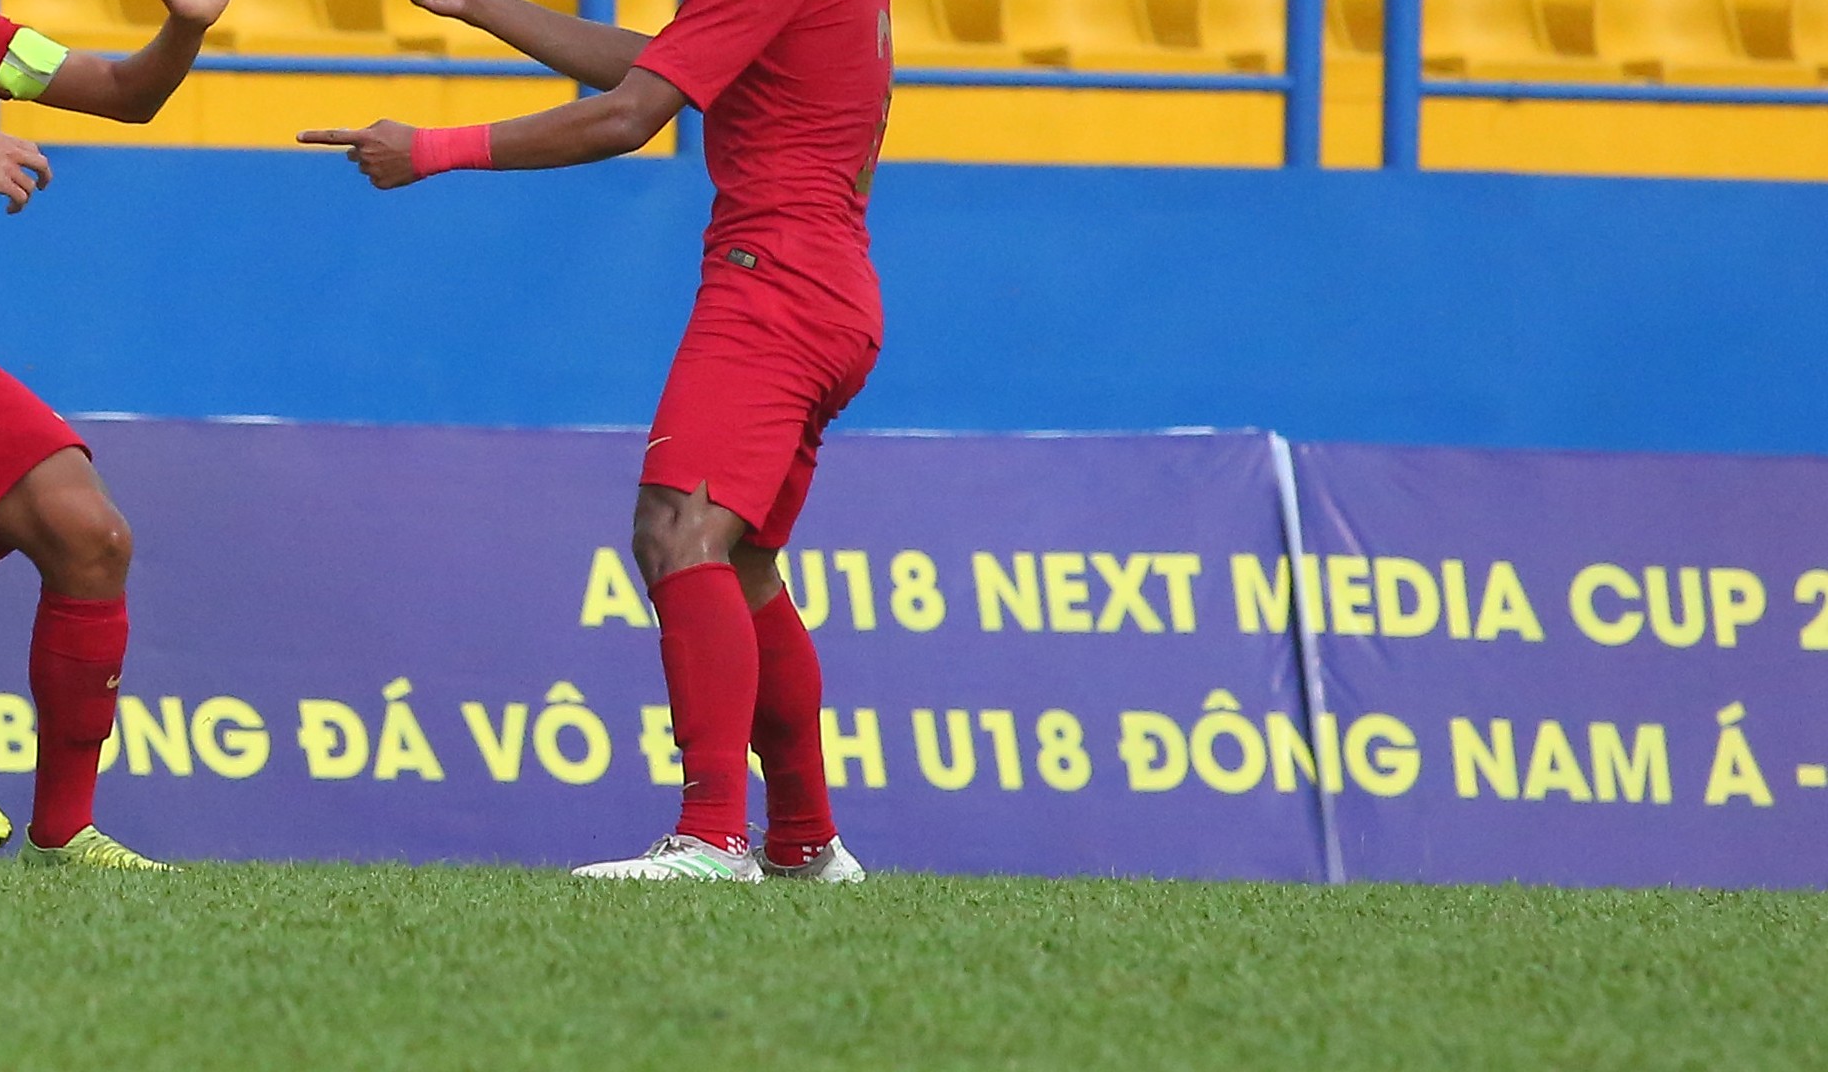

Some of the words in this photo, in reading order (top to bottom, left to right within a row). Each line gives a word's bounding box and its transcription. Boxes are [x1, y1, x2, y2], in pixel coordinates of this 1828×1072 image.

[973, 551, 1200, 633] NEXT
[1231, 553, 1545, 643] MEDIA
[1569, 563, 1767, 649] CUP
[298, 678, 444, 781] ĐÁ
[461, 680, 613, 785] VÔ
[910, 708, 1093, 791] U18
[1118, 688, 1422, 797] ĐÔNG
[1450, 717, 1672, 805] NAM
[1704, 701, 1774, 807] Á
